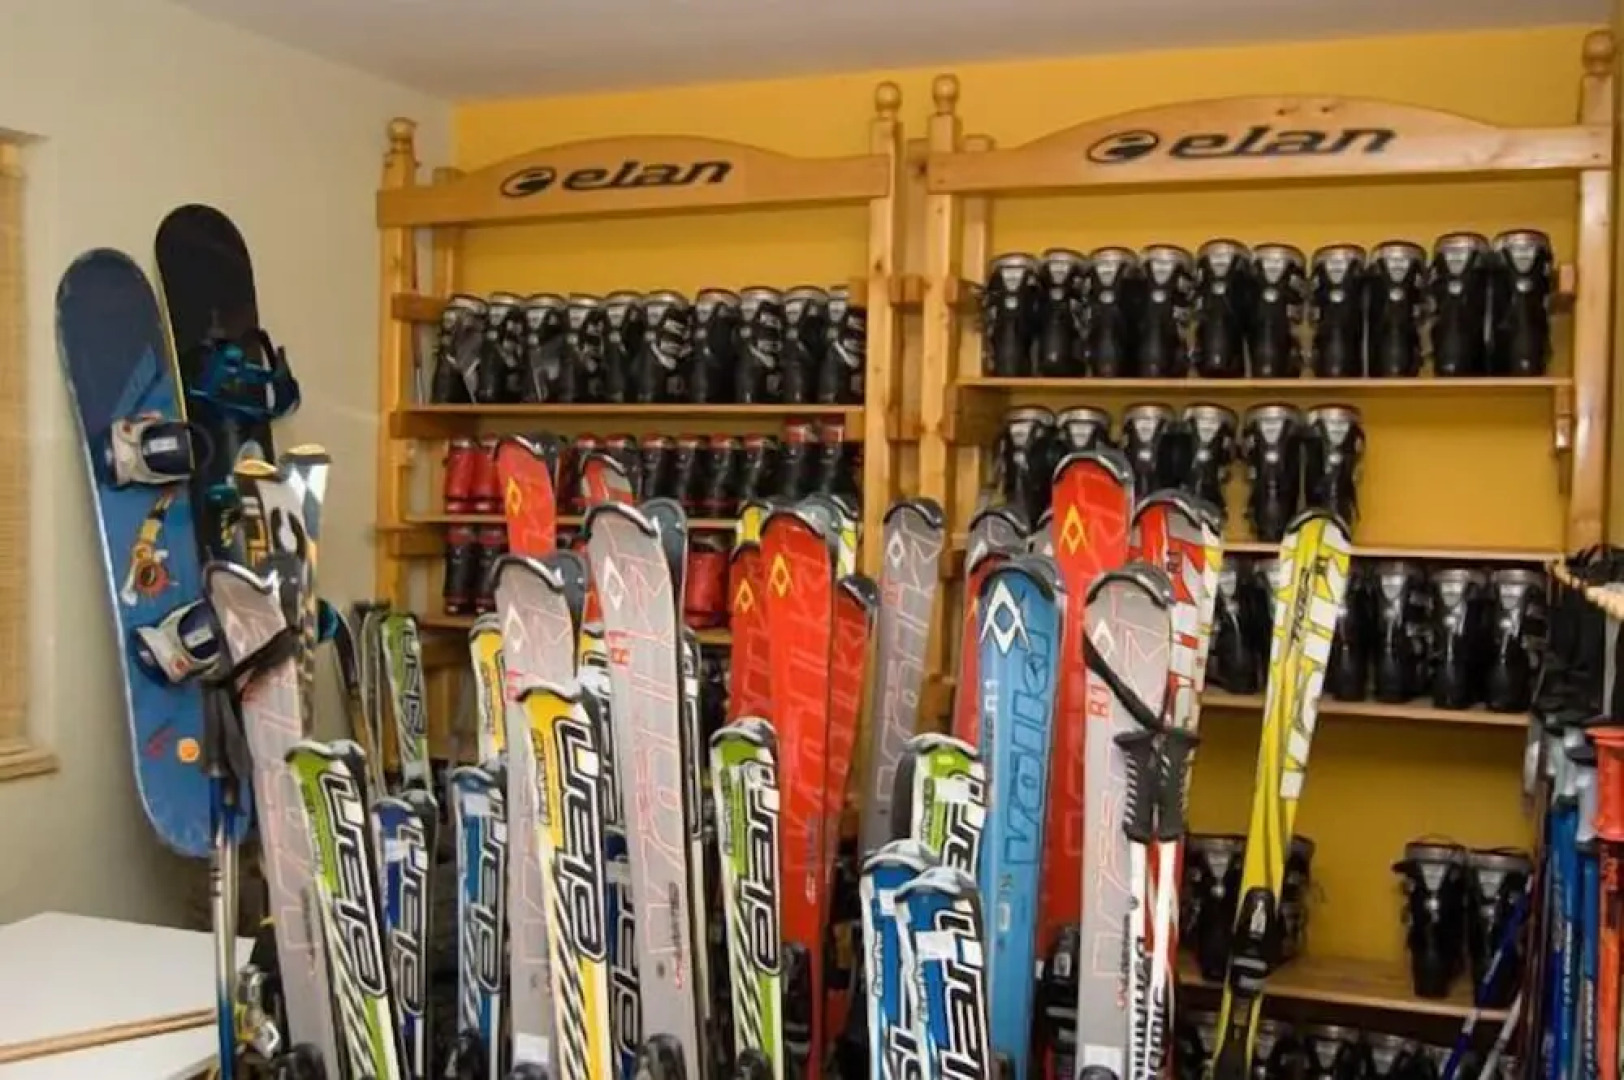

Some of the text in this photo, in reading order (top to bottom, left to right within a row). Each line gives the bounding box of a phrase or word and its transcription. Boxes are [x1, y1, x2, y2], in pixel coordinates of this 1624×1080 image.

[562, 160, 734, 190] elan
[1167, 125, 1396, 159] elan
[1088, 683, 1109, 717] R1
[319, 773, 387, 998] elan
[552, 715, 606, 963] elan
[741, 760, 781, 975] elan
